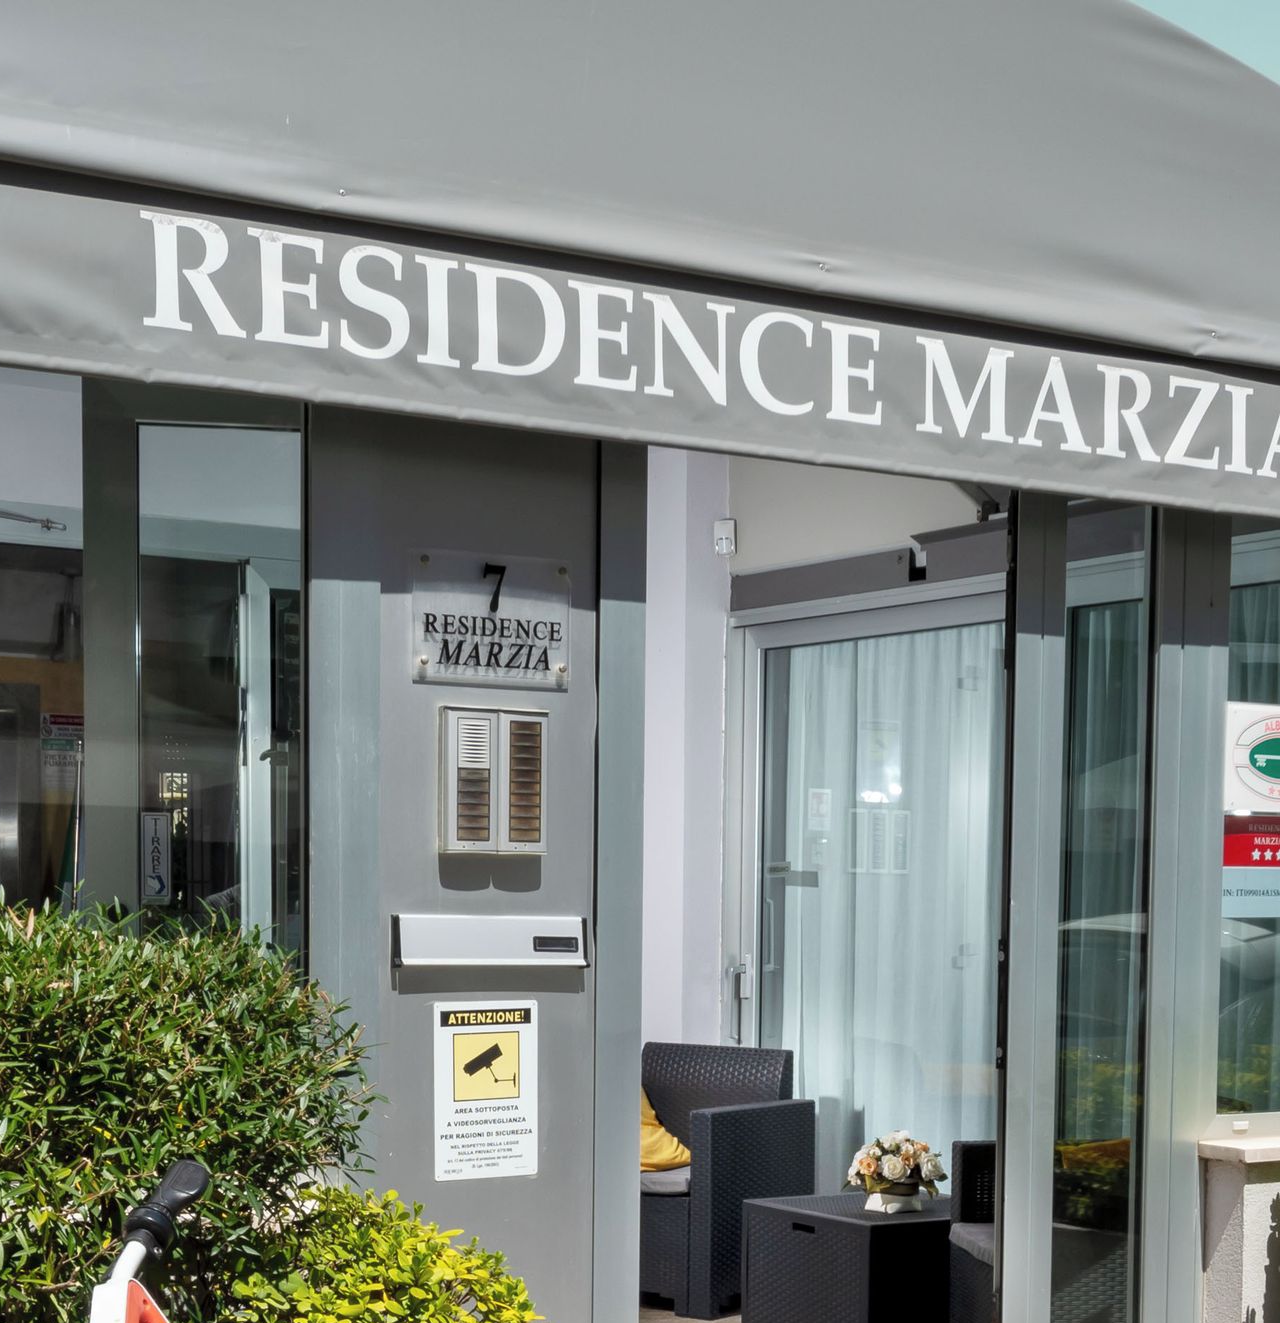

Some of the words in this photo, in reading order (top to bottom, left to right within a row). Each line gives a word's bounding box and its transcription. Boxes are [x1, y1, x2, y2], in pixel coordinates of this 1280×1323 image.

[141, 211, 884, 428] RESIDENCE
[482, 562, 507, 613] 7
[423, 612, 563, 642] RESIDENCE
[436, 638, 551, 671] MARZIA
[150, 817, 162, 874] TIRARE
[448, 1010, 525, 1025] ATTENZIONE!
[453, 1116, 527, 1127] VIDEOSORVEGLIANZA
[454, 1107, 473, 1115] AREA
[474, 1104, 519, 1113] SOTTOPOSTA
[495, 1128, 533, 1137] SICUREZZA
